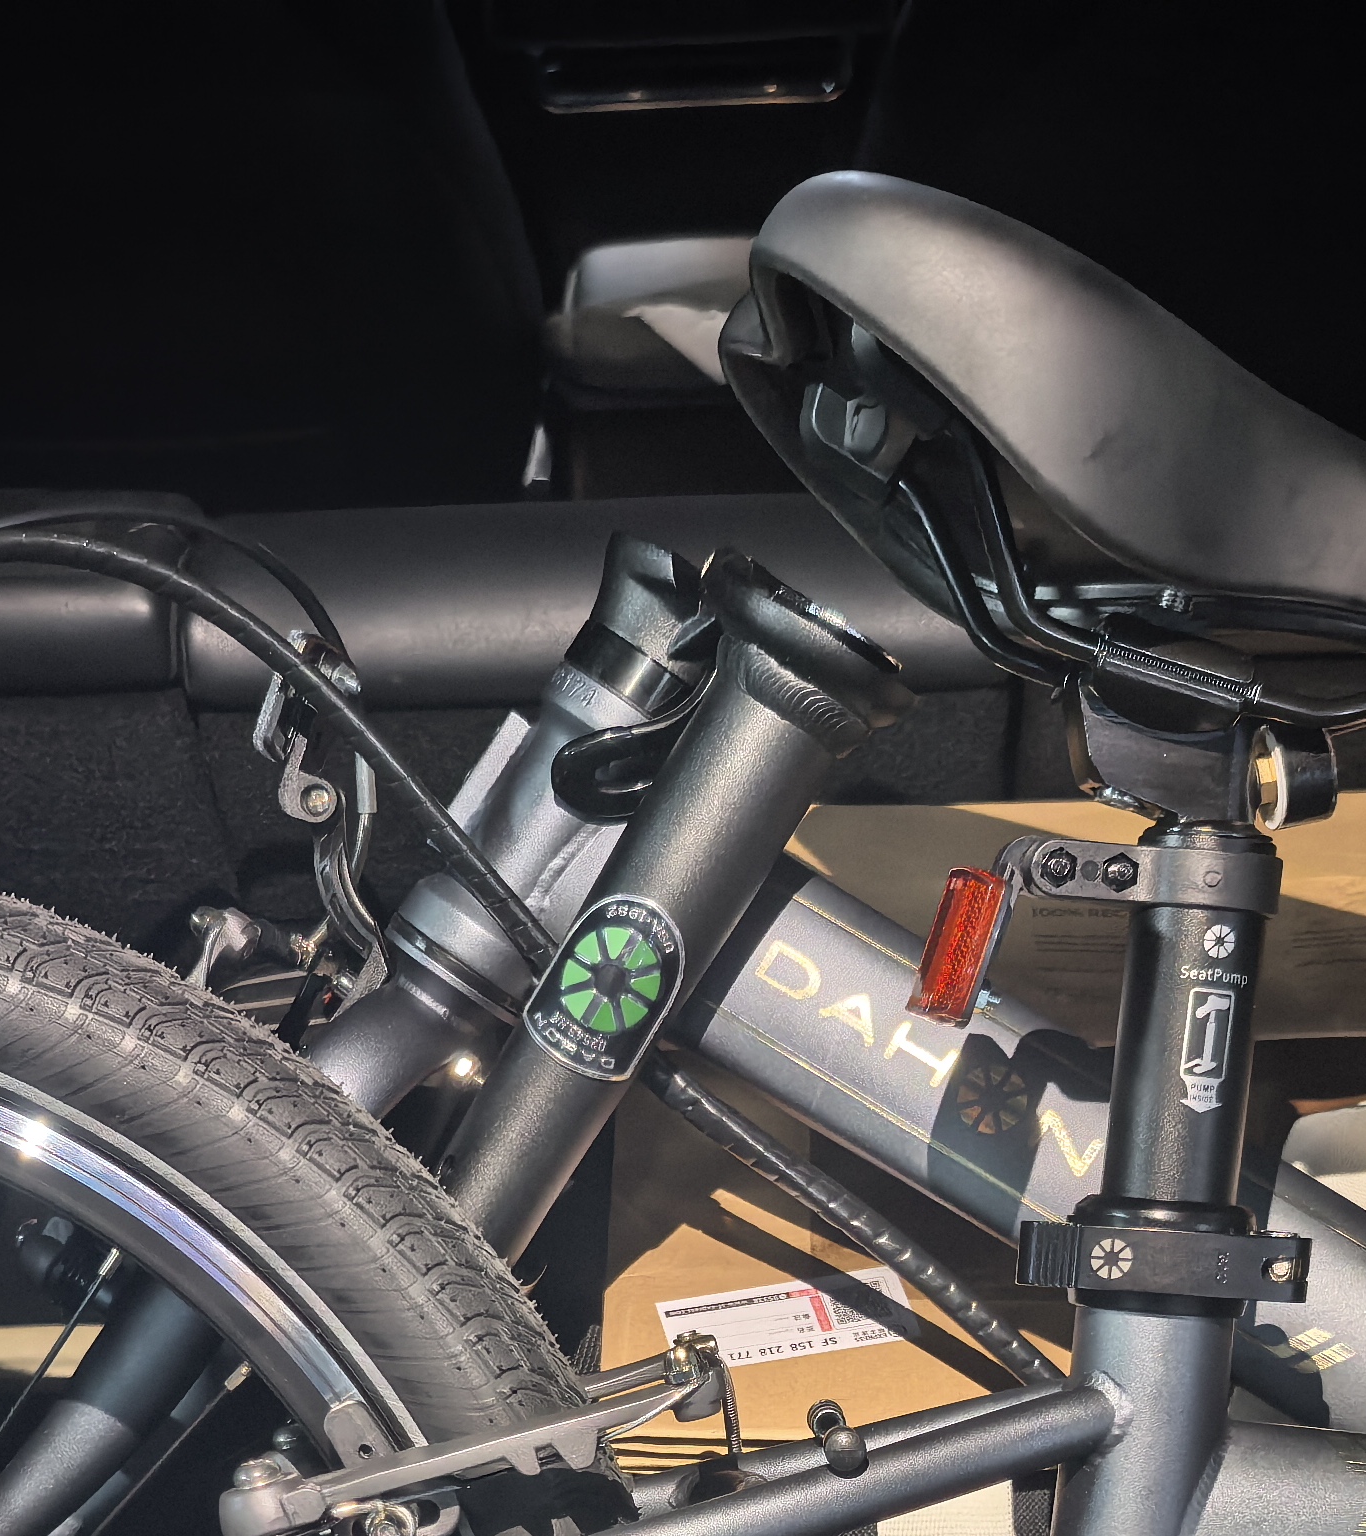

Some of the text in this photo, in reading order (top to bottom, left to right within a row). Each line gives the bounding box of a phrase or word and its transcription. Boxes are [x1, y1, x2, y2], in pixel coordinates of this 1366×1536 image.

[1179, 965, 1249, 988] SeatPump
[1190, 1083, 1215, 1093] PUMP
[1189, 1094, 1214, 1104] INSIDE
[728, 1336, 838, 1361] SF 158 218 771
